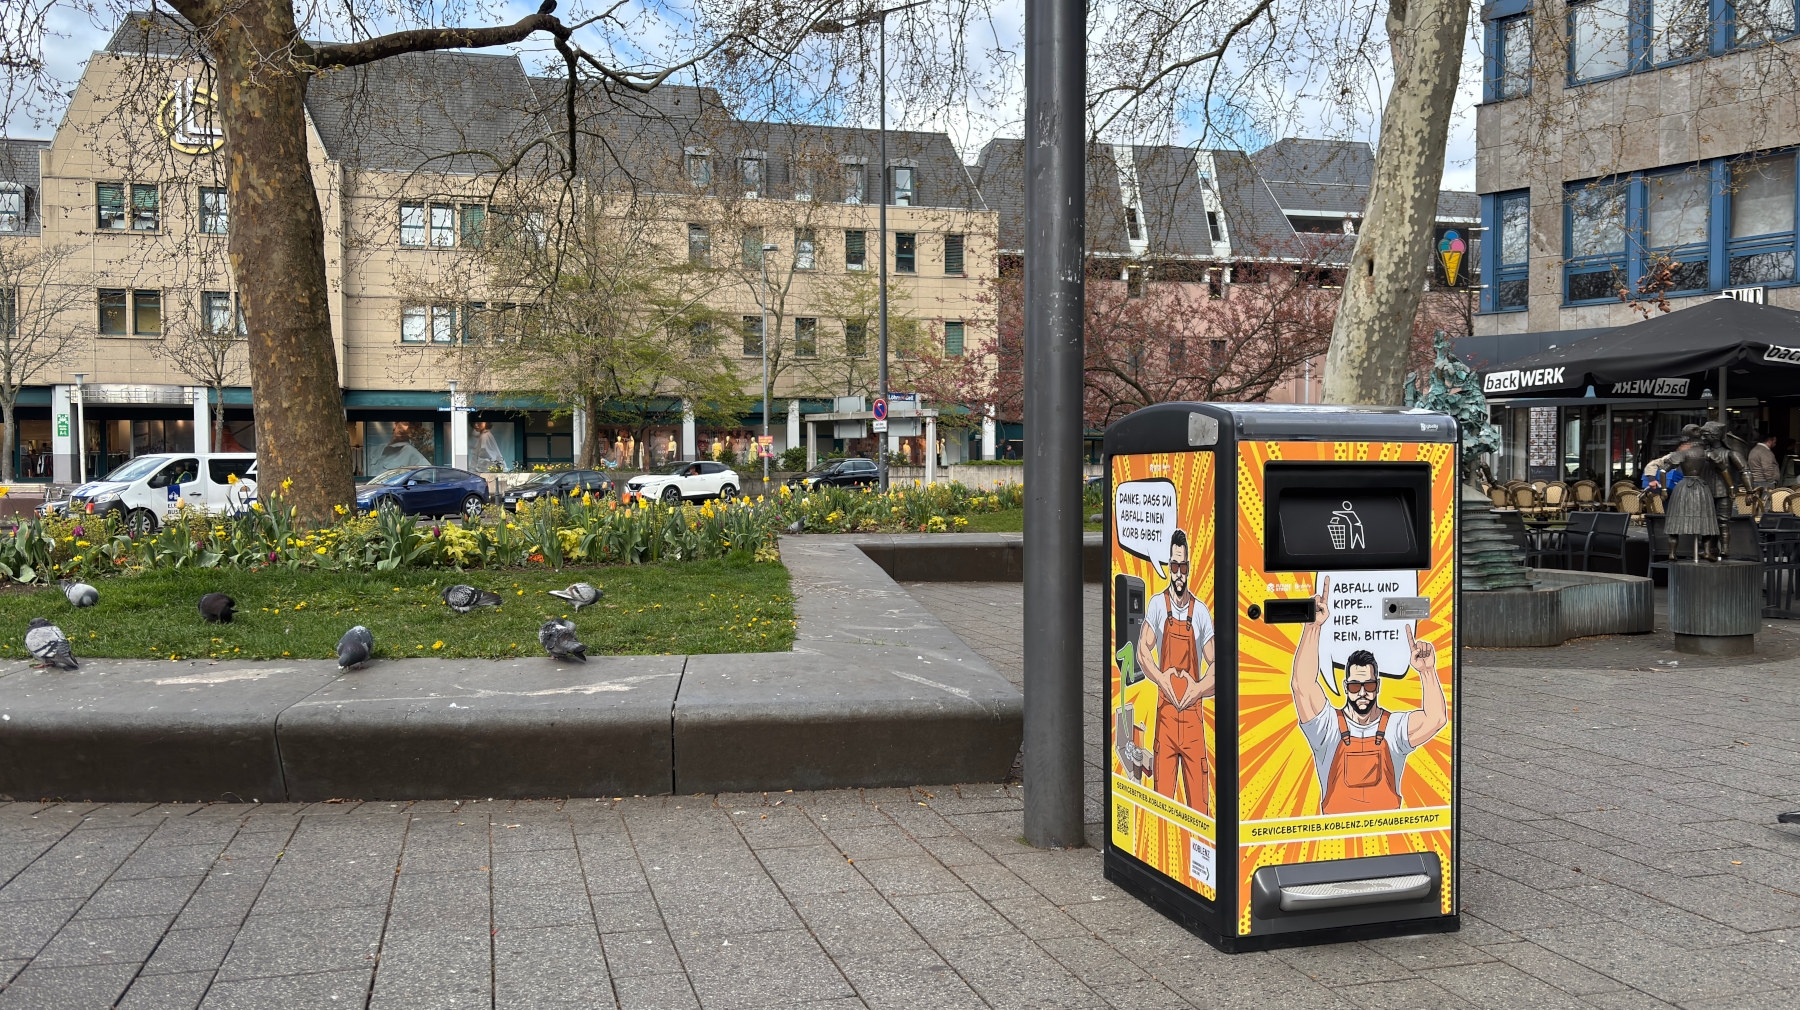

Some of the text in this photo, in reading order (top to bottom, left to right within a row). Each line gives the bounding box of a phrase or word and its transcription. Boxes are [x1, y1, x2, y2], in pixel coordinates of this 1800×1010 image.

[1119, 492, 1172, 508] DANKE, DASS DU
[1120, 511, 1164, 525] ABFALL EINEN
[1122, 527, 1162, 543] KORB GIBST!
[1333, 582, 1400, 594] ABFALL UND
[1333, 599, 1372, 609] KIPPE...
[1333, 616, 1359, 625] HIER
[1333, 629, 1399, 642] REIN, BITTE!
[1251, 814, 1440, 837] SERVICEBETRIEB.KOBLENZ.DE/SAUBERESTADT
